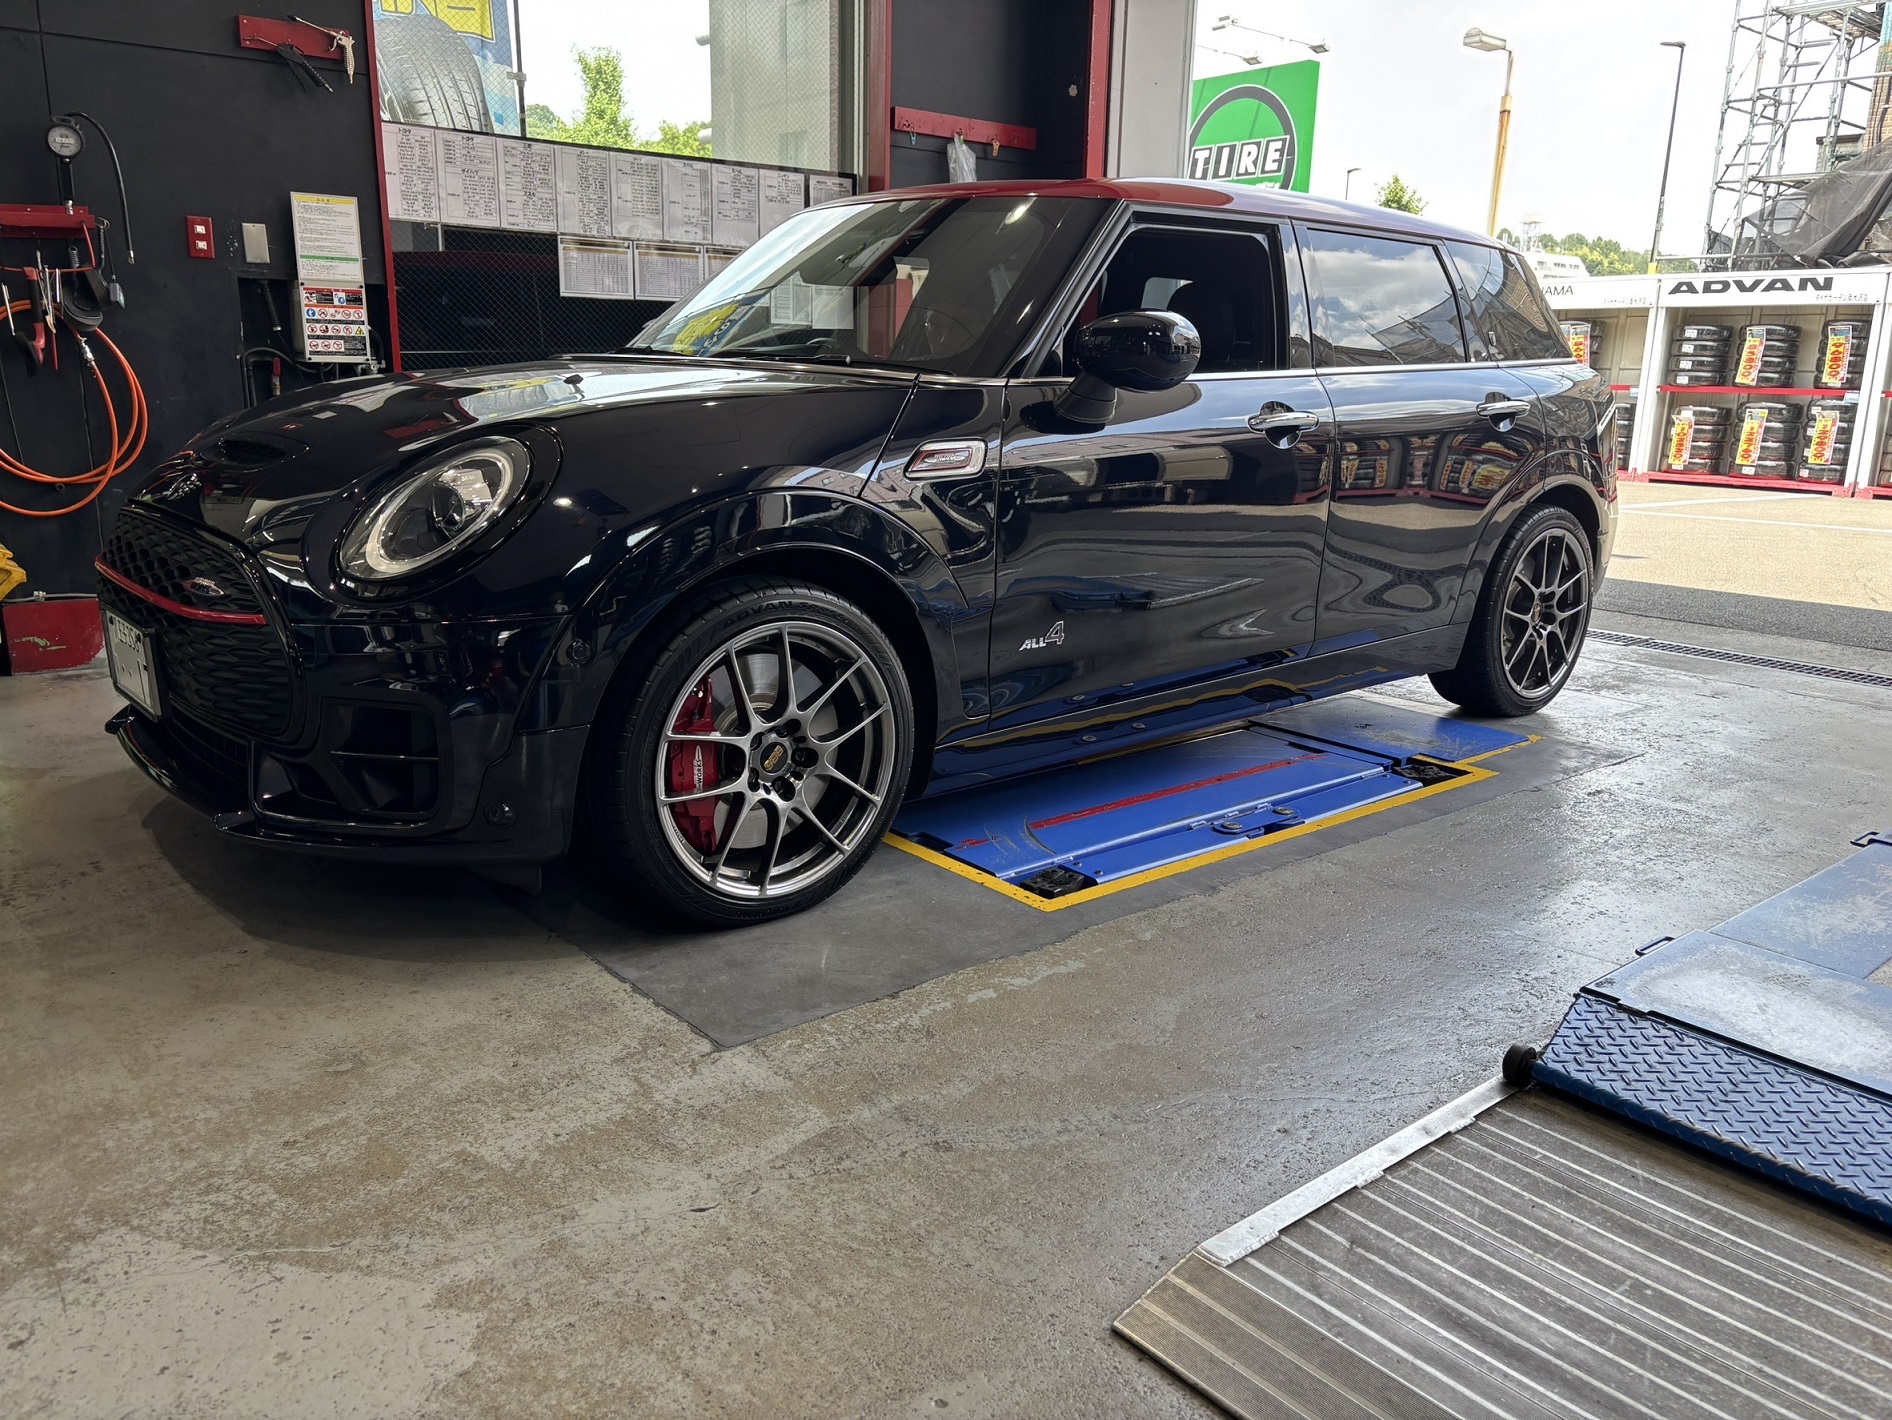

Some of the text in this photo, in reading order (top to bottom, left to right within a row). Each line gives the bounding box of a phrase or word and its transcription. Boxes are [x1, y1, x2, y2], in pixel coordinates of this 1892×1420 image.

[1194, 140, 1283, 179] TIRE
[1541, 285, 1574, 296] AMA
[1667, 276, 1834, 295] ADVAN
